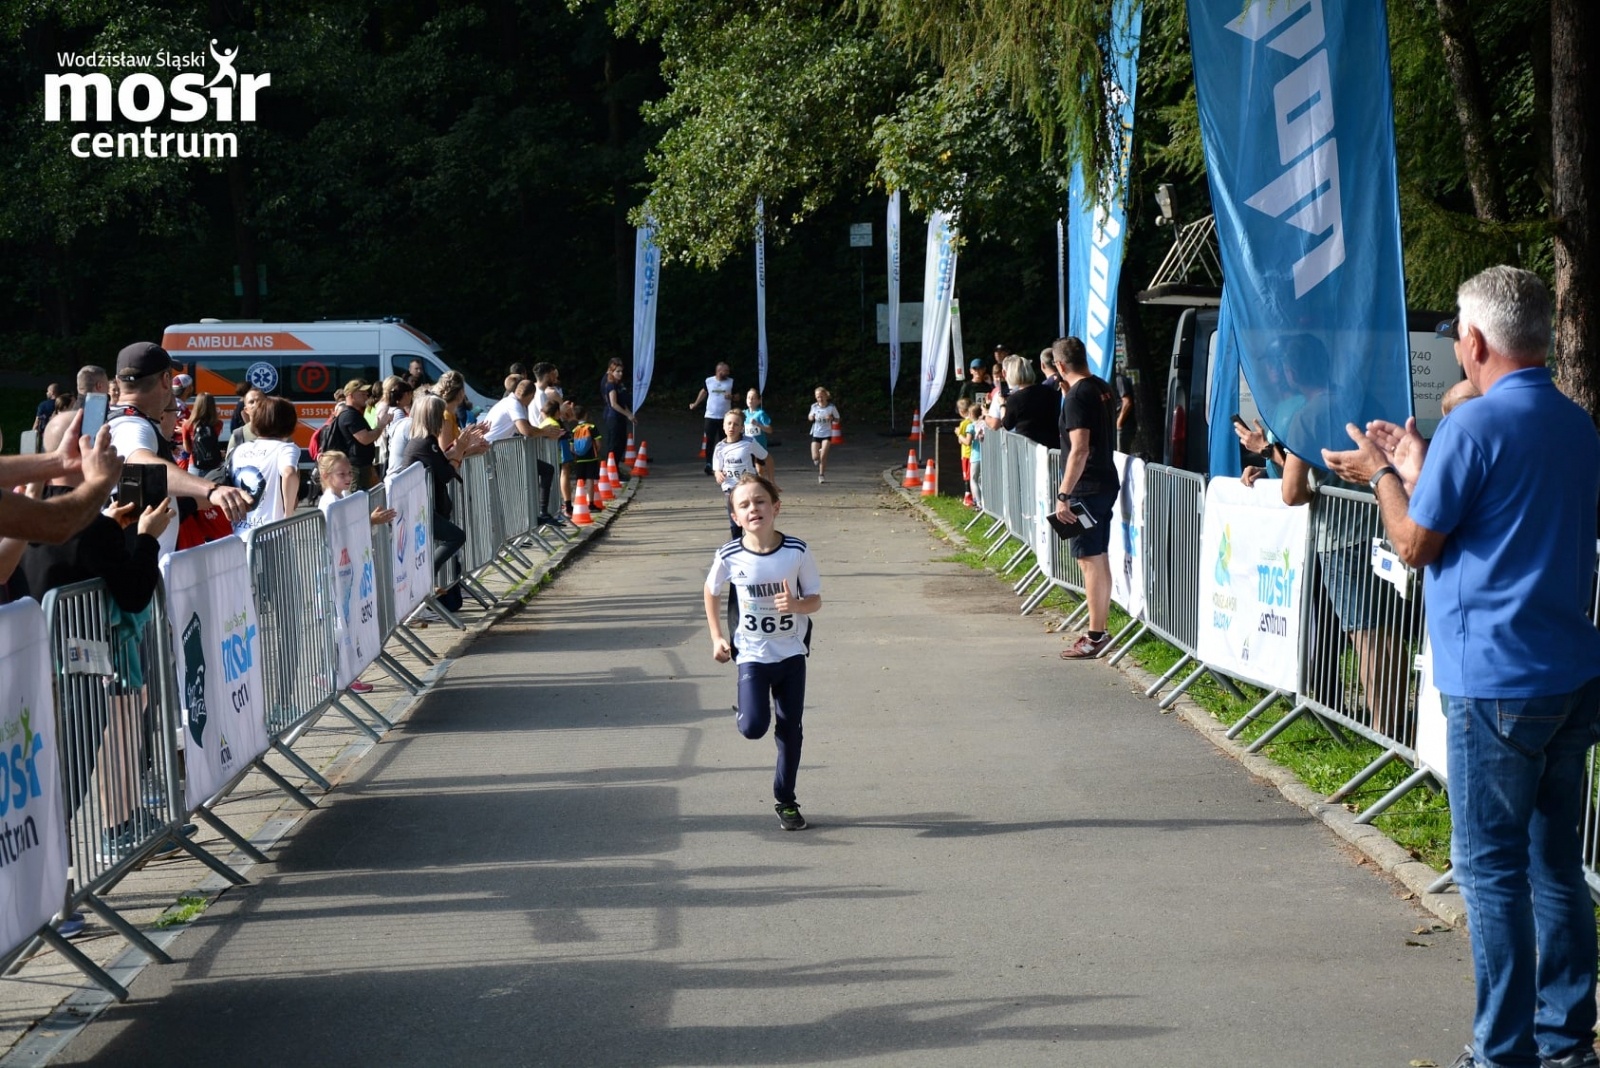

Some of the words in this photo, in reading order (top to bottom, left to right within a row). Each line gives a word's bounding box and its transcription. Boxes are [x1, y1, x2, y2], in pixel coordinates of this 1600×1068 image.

[187, 336, 274, 348] AMBULANS
[1411, 351, 1432, 361] 740
[744, 614, 794, 633] 365
